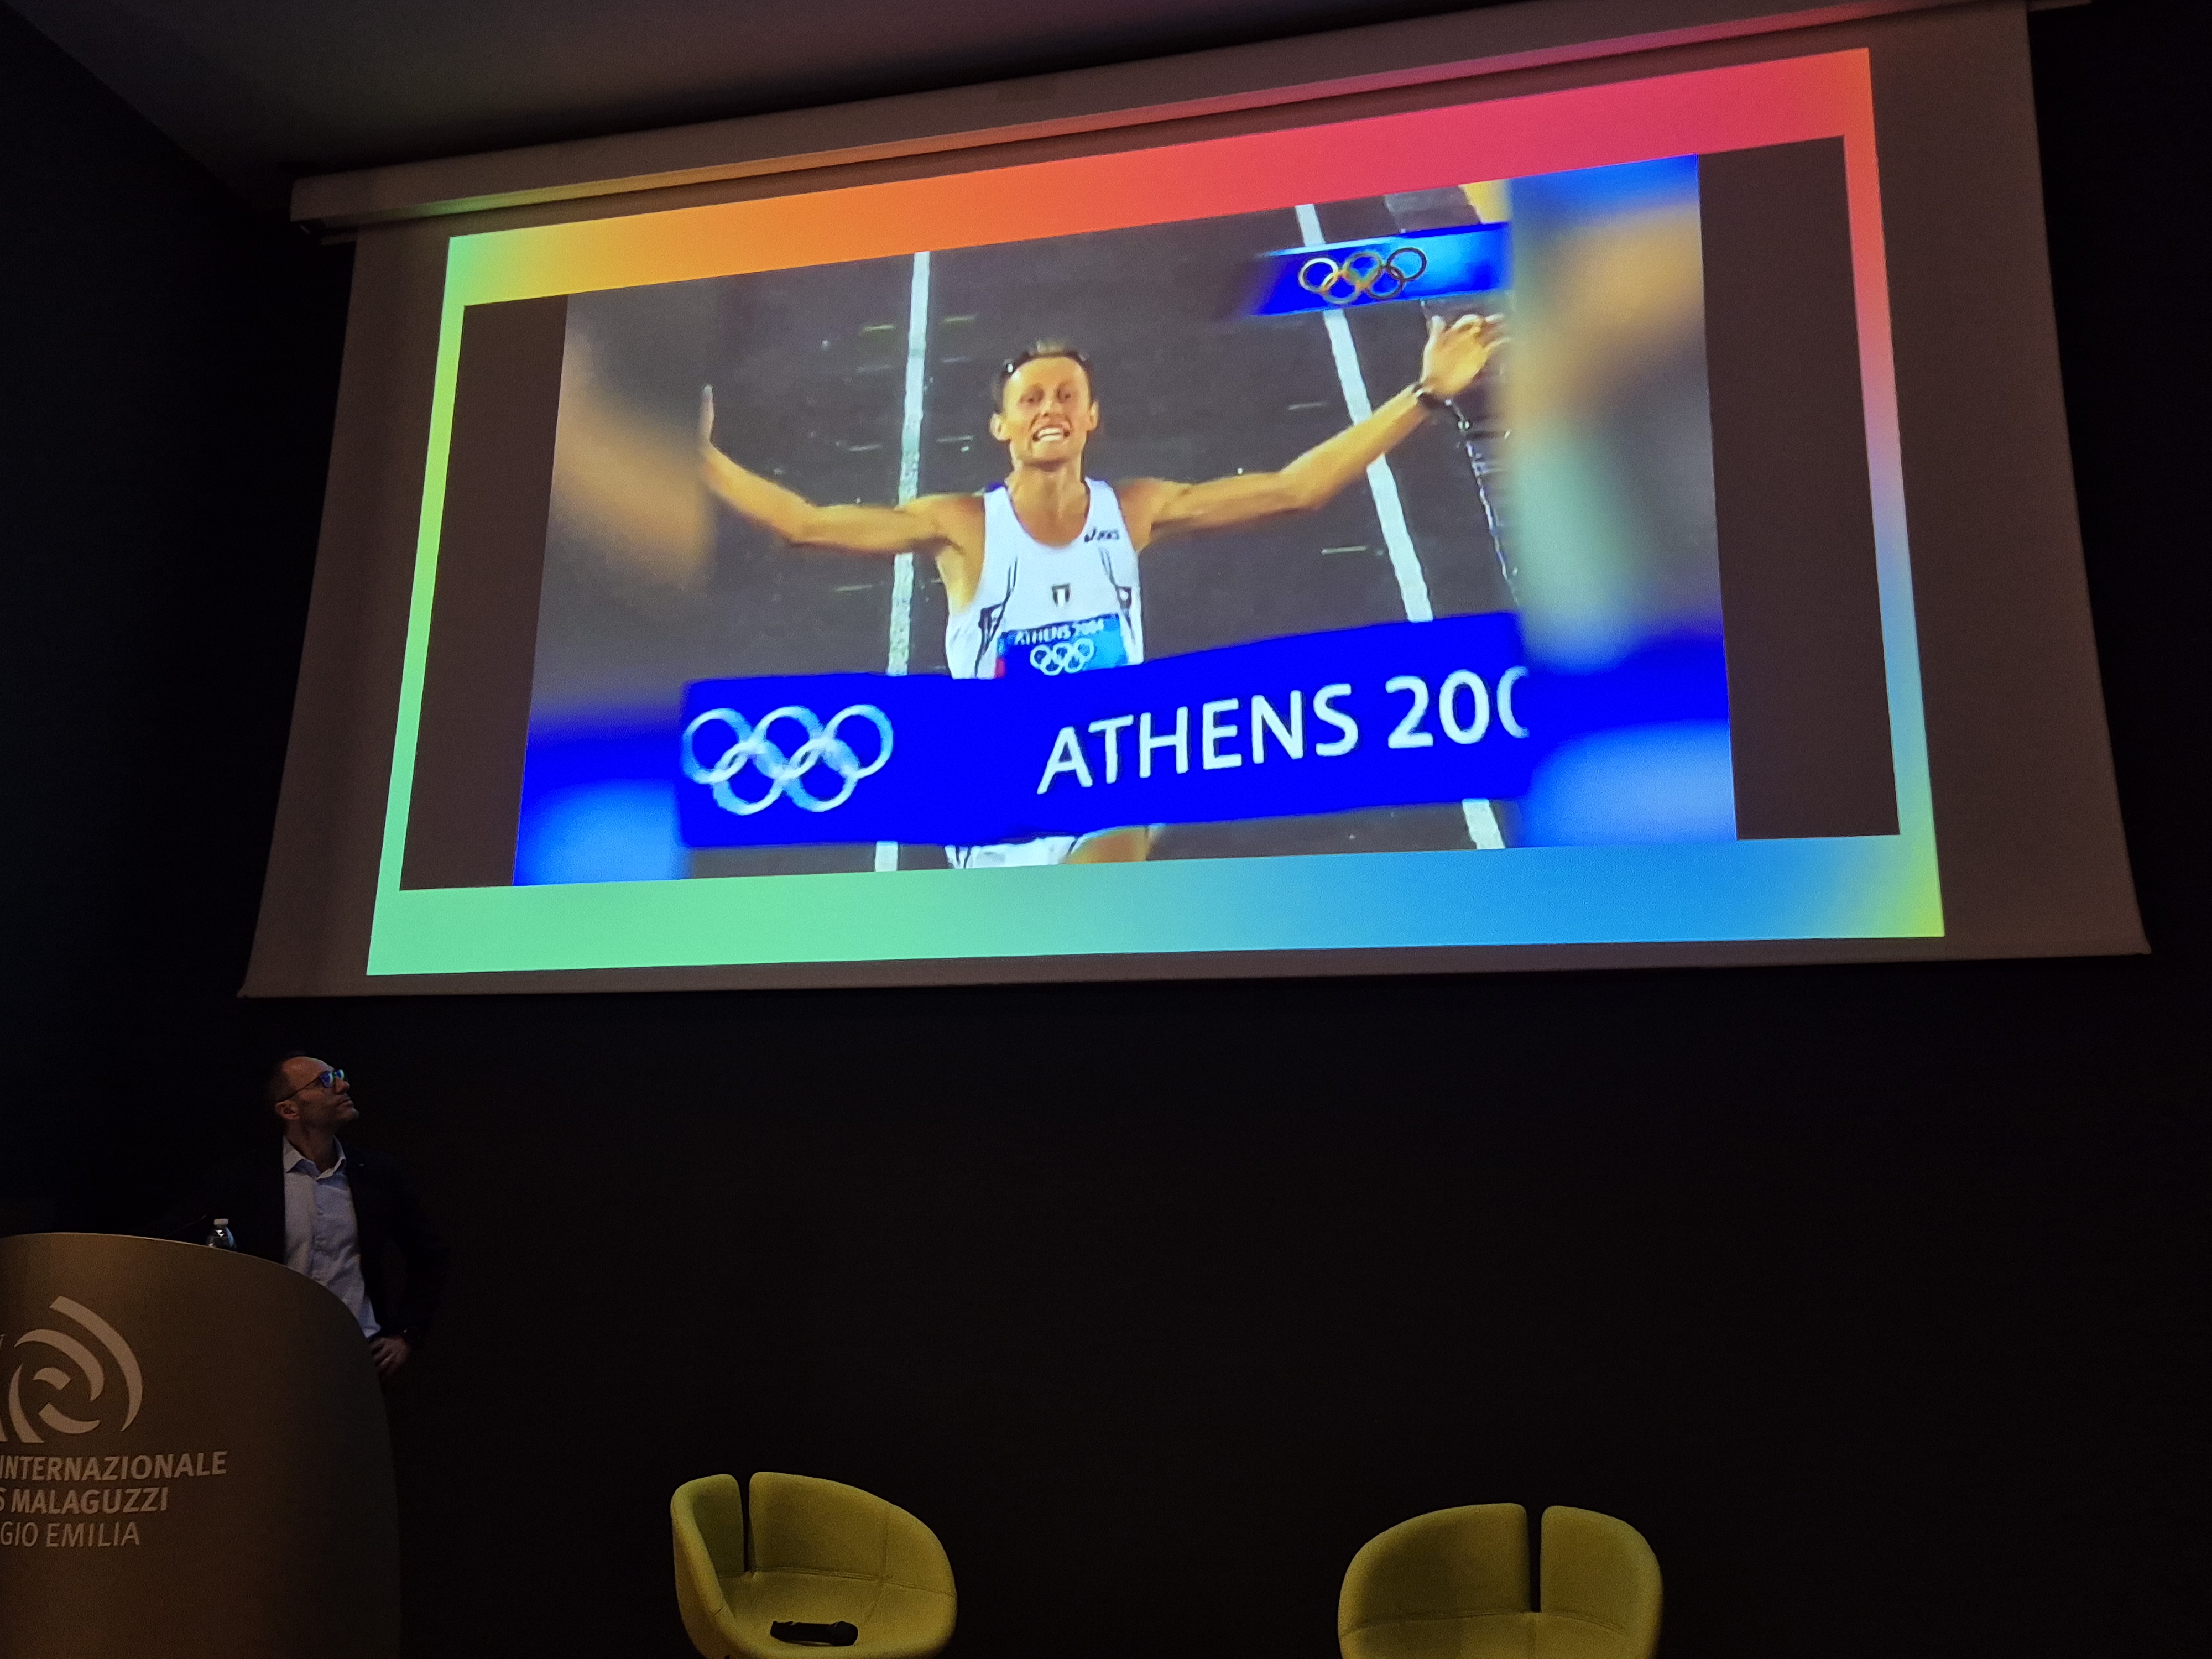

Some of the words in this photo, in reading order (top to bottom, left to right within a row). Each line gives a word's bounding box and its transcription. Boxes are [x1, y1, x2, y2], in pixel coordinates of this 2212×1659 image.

[1037, 683, 1359, 795] ATHENS
[0, 1450, 228, 1482] INTERNAZIONALE
[11, 1487, 168, 1514] MALAGUZZI
[1, 1520, 39, 1547] GIO
[45, 1521, 140, 1548] EMILIA
